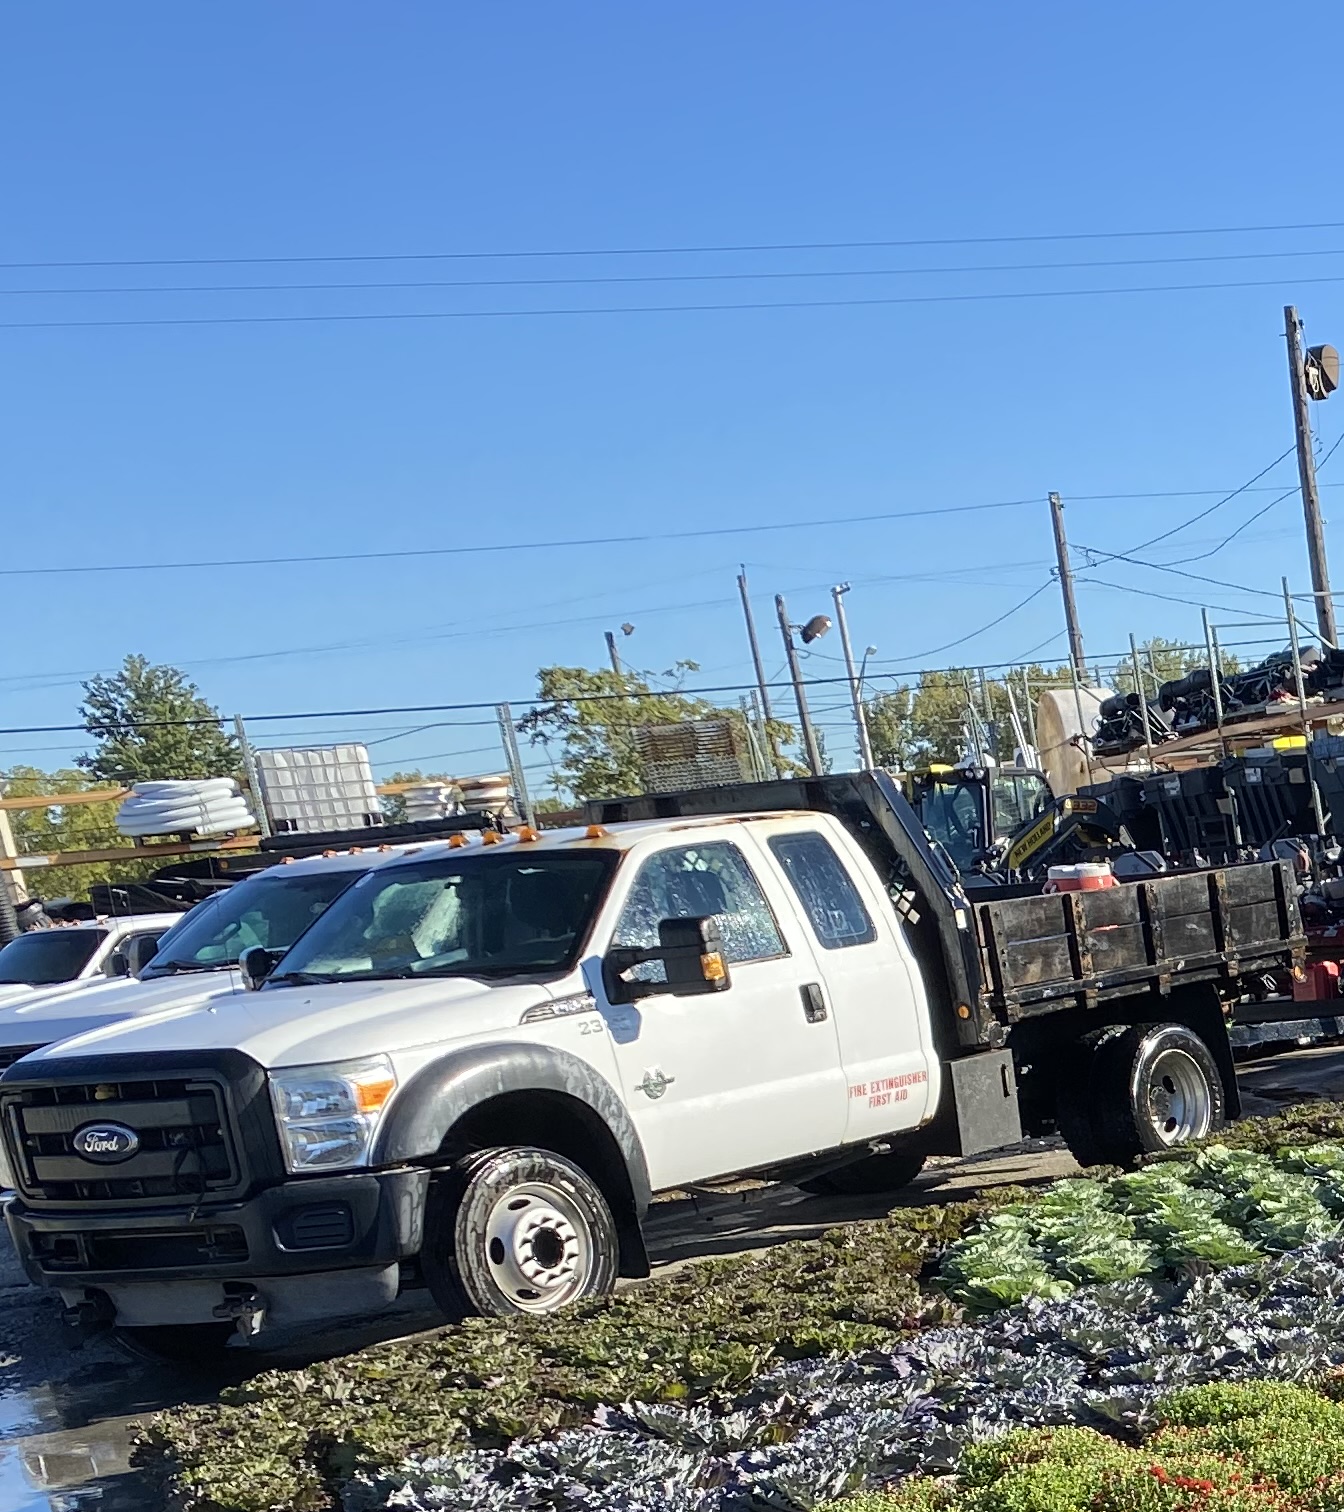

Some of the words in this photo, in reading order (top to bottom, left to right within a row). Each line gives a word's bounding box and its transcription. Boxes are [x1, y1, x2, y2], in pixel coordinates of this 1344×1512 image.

[849, 1084, 868, 1098] FIRE
[870, 1071, 928, 1093] EXTINGUISHER
[868, 1092, 892, 1109] FIRST
[894, 1088, 908, 1102] AID
[84, 1131, 119, 1153] Ford
